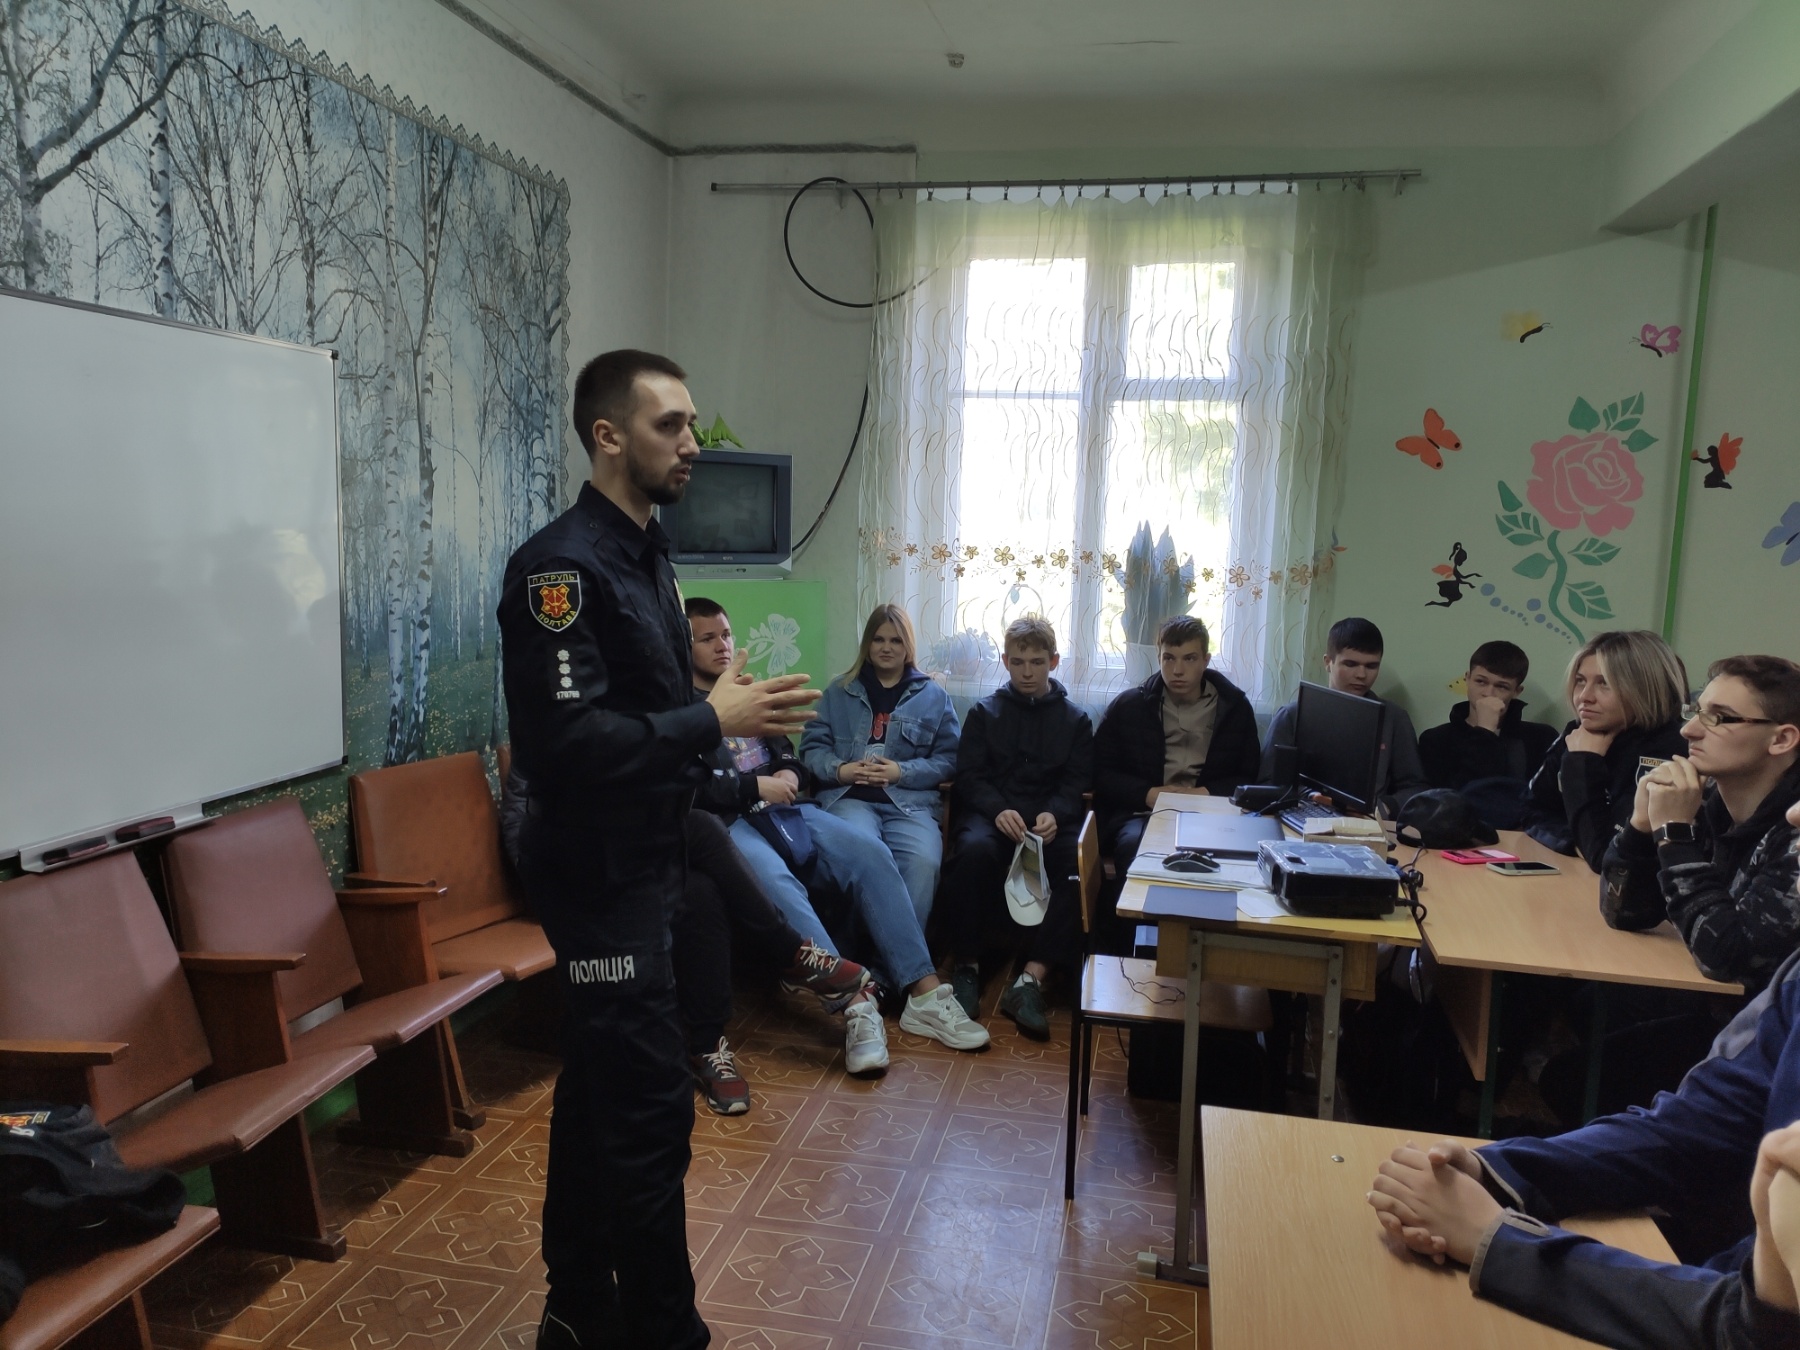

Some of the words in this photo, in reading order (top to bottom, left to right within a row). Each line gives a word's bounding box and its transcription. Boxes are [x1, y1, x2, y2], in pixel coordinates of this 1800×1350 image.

[532, 574, 575, 585] ПАТРУЛЬ
[537, 610, 577, 627] ПОЛТАВА
[569, 955, 635, 984] ПОЛІЦІЯ
